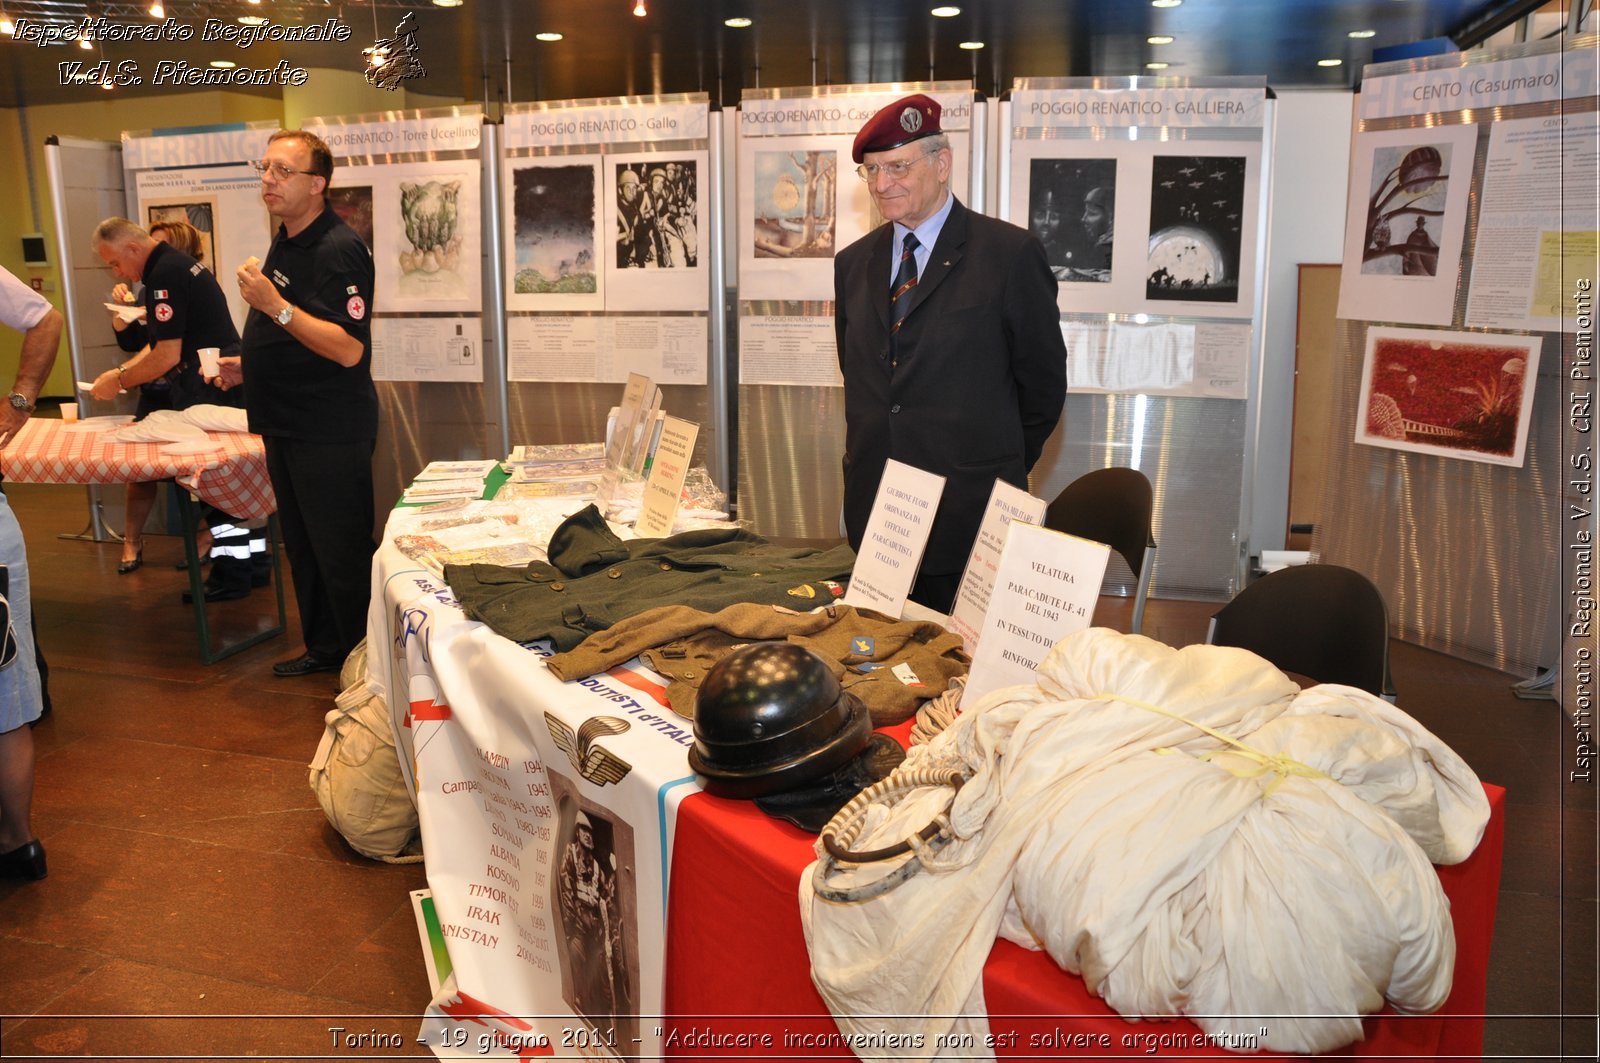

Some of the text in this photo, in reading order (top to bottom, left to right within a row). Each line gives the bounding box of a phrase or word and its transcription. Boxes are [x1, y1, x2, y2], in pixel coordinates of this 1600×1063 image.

[1413, 68, 1560, 101] CENTO (Casumaro)
[742, 109, 785, 124] POGGIO
[787, 108, 841, 122] RENATICO
[1031, 101, 1088, 115] POGGIO
[1092, 101, 1162, 114] RENATICO
[1175, 100, 1245, 115] GALLIERA
[344, 131, 394, 145] RENATICO
[401, 130, 428, 142] Torre
[431, 126, 480, 141] Uccellino
[531, 121, 576, 136] POGGIO
[580, 119, 636, 134] RENATICO
[646, 116, 677, 129] Gallo
[887, 486, 929, 509] GIUBBONE FUORI
[884, 503, 921, 525] ORDINANZA DA
[884, 520, 911, 537] UFFICIALE
[872, 532, 913, 558] PARACADUTISTA
[875, 551, 900, 569] ITALIANO
[1031, 561, 1075, 584] VELATURA
[1008, 581, 1086, 617] PARACADUTE I.F. 41
[1025, 602, 1059, 622] DEL 1943
[996, 619, 1053, 649] IN TESSUTO DI
[490, 844, 521, 871] ALBANIA
[487, 864, 520, 892] KOSOVO
[469, 884, 507, 906] TIMOR
[508, 896, 520, 915] EST
[467, 905, 502, 926] IRAK
